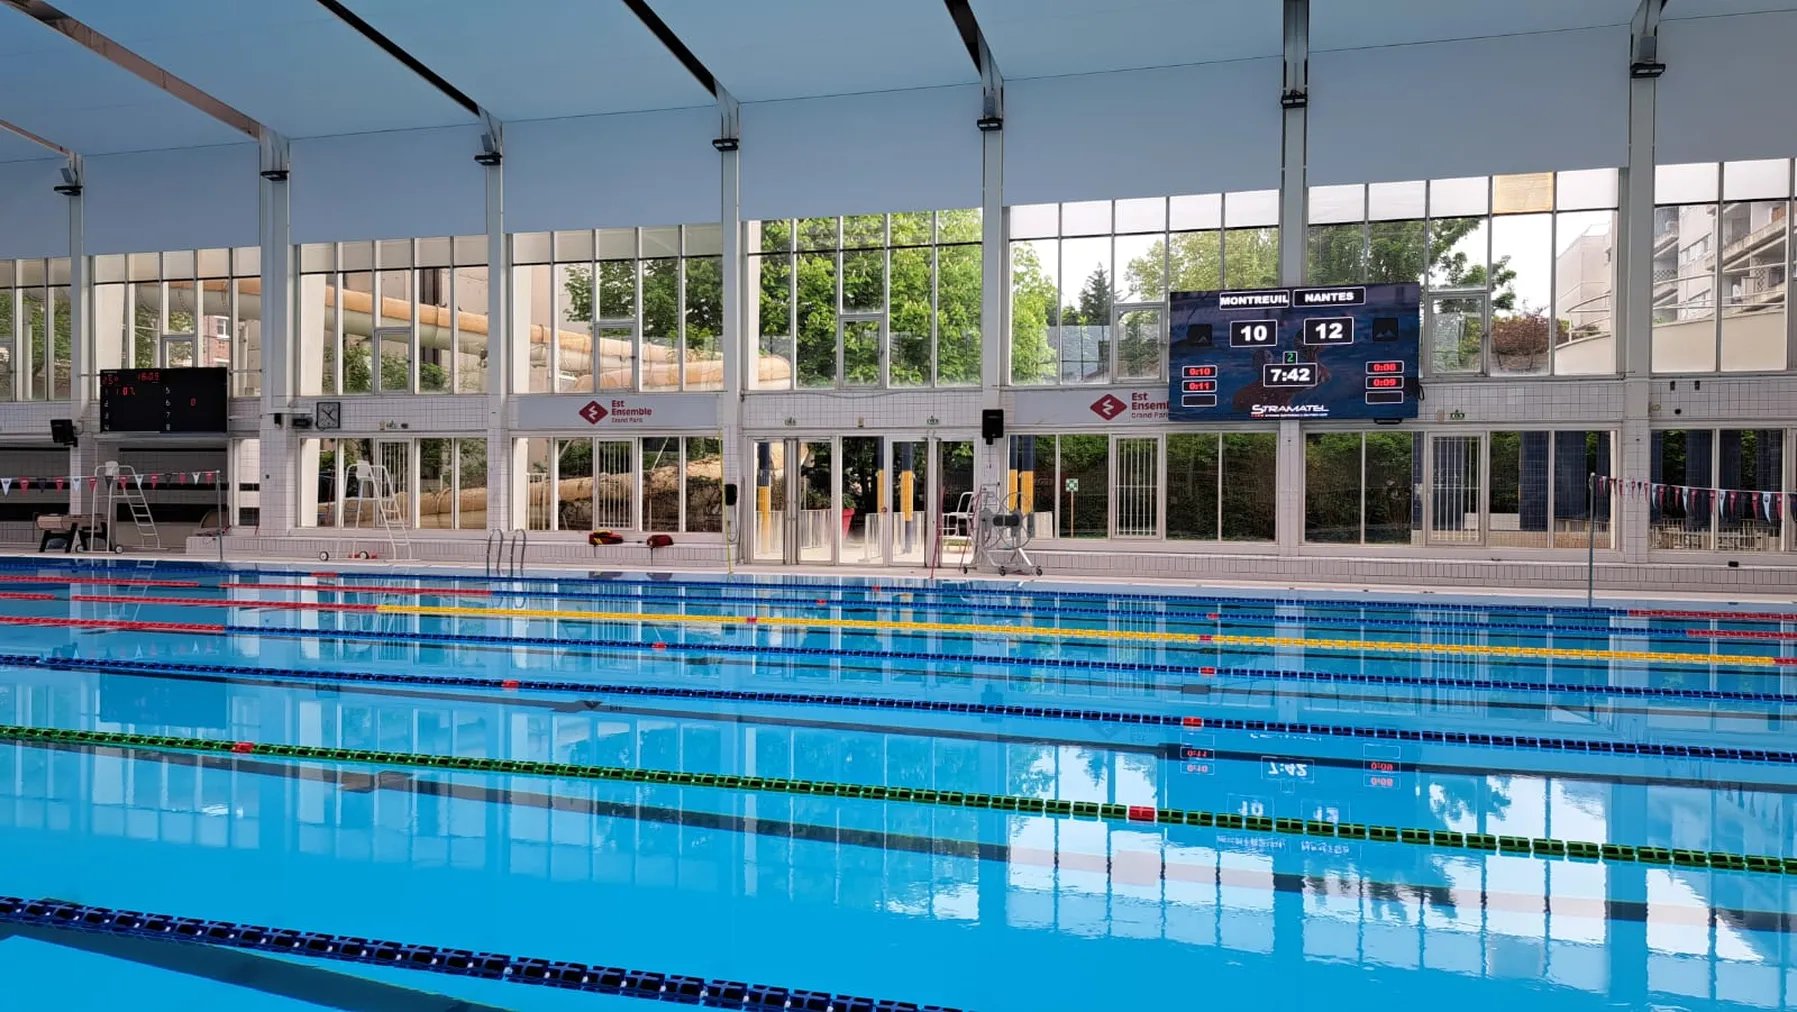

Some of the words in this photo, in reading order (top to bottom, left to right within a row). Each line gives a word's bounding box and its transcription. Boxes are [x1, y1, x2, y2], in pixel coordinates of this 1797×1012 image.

[1219, 291, 1289, 306] MONTREUIL
[1304, 291, 1354, 303] NANTES
[1240, 325, 1268, 341] 10
[1314, 322, 1343, 339] 12
[1286, 353, 1294, 363] 2
[1189, 367, 1211, 376] 0:10
[1270, 368, 1311, 382] 7:42
[1189, 382, 1210, 390] 0:11
[1131, 392, 1148, 401] Est
[611, 399, 625, 407] Est
[611, 407, 652, 416] Ensemble
[1251, 404, 1330, 414] STRAMATEL
